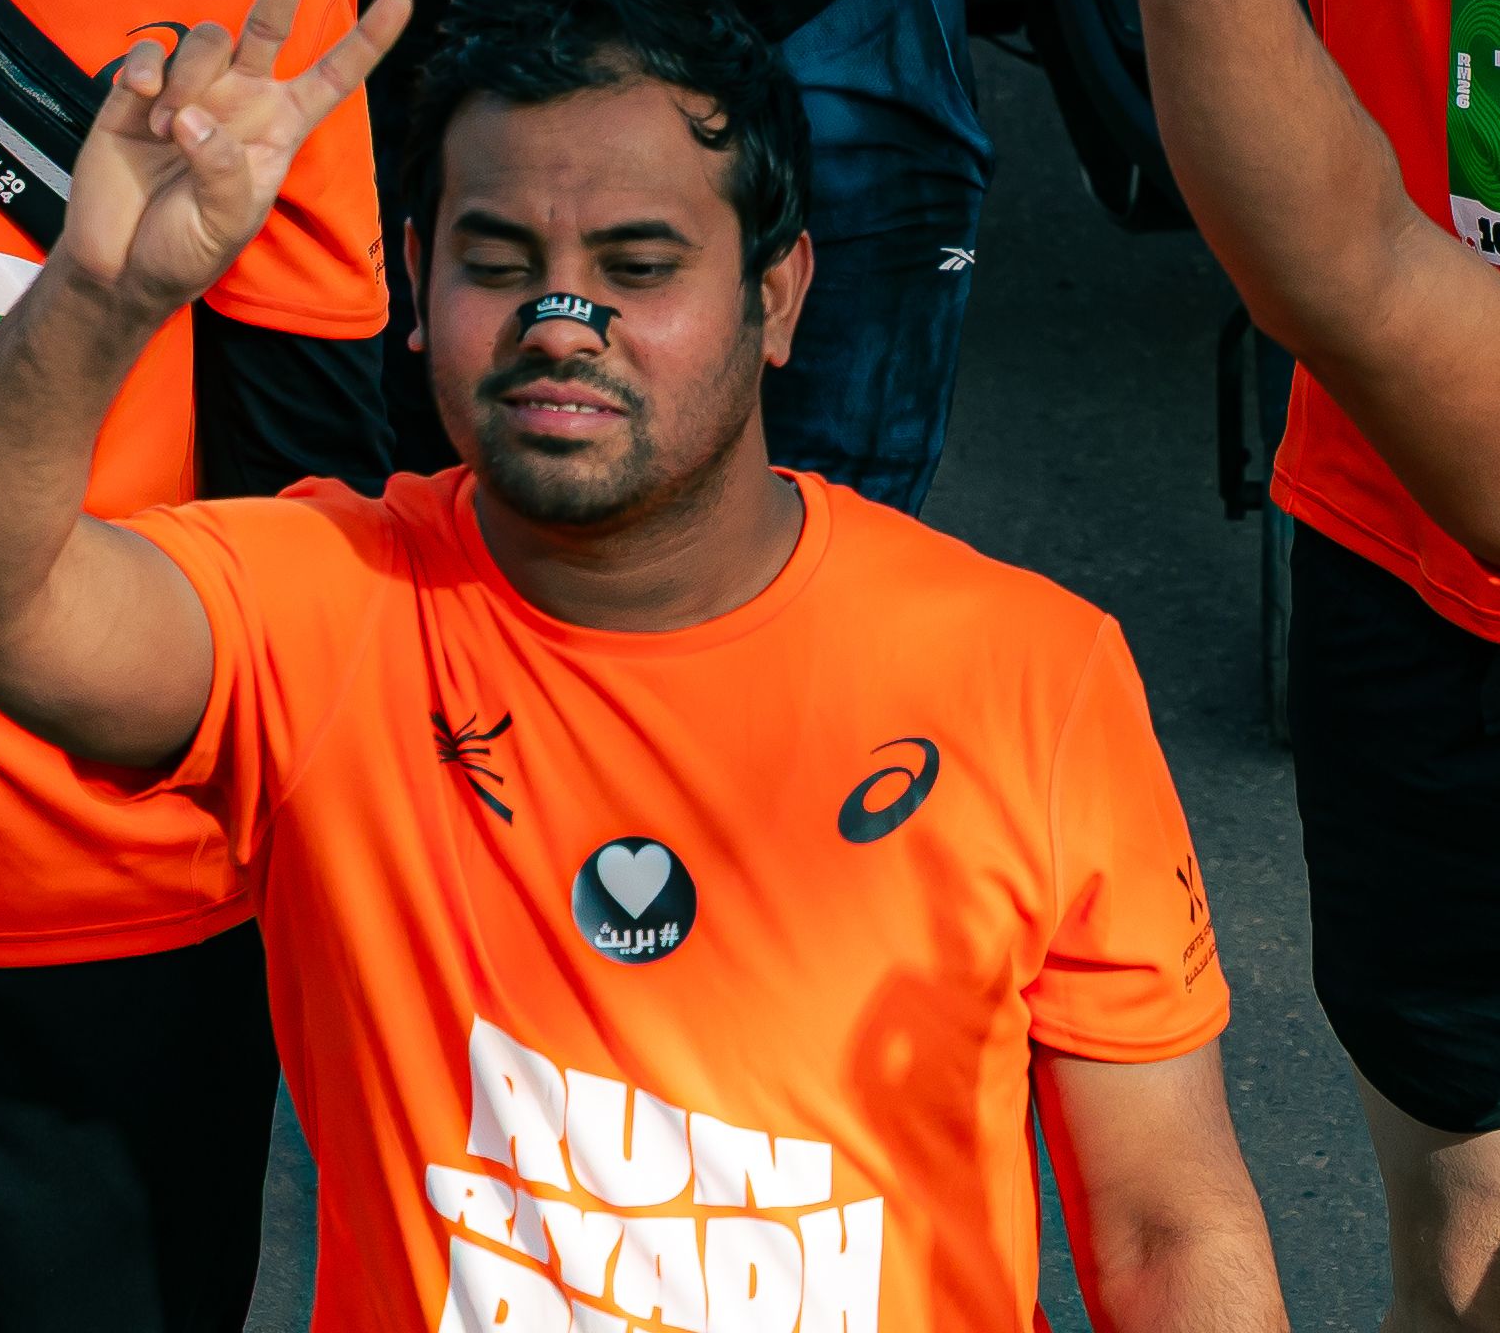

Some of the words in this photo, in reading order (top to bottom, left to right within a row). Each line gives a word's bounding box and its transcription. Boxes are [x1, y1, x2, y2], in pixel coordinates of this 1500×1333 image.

[1455, 52, 1471, 109] RM26
[0, 169, 27, 195] 20
[466, 1015, 833, 1210] RUN
[425, 1162, 885, 1333] RIYADH
